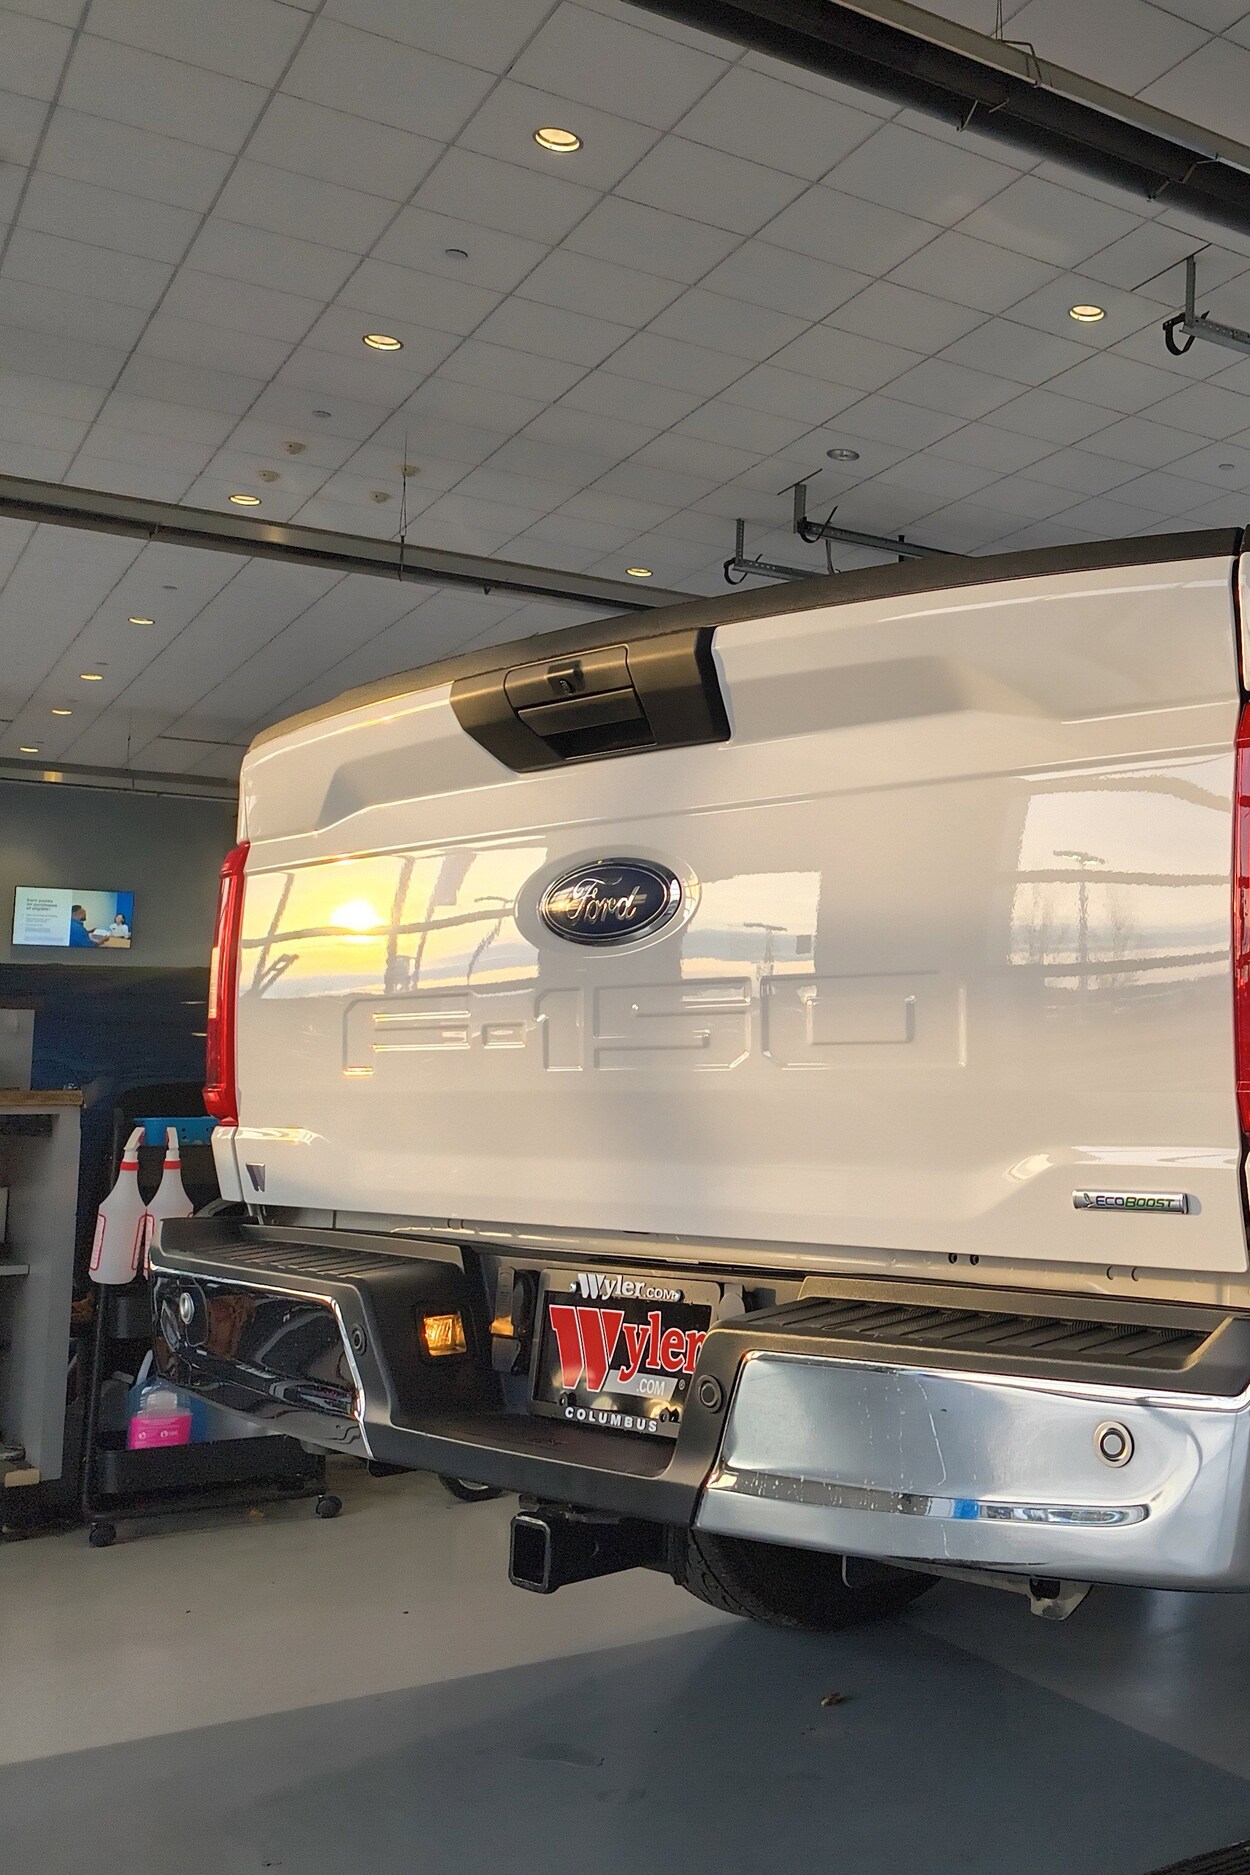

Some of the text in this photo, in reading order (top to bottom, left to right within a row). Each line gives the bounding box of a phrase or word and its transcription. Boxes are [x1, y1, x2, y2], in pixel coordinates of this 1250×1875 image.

[567, 875, 641, 922] Ford
[342, 971, 967, 1076] F-150
[549, 1304, 708, 1392] Wyler
[636, 1379, 666, 1396] .COM
[565, 1406, 658, 1433] COLUMBUS
